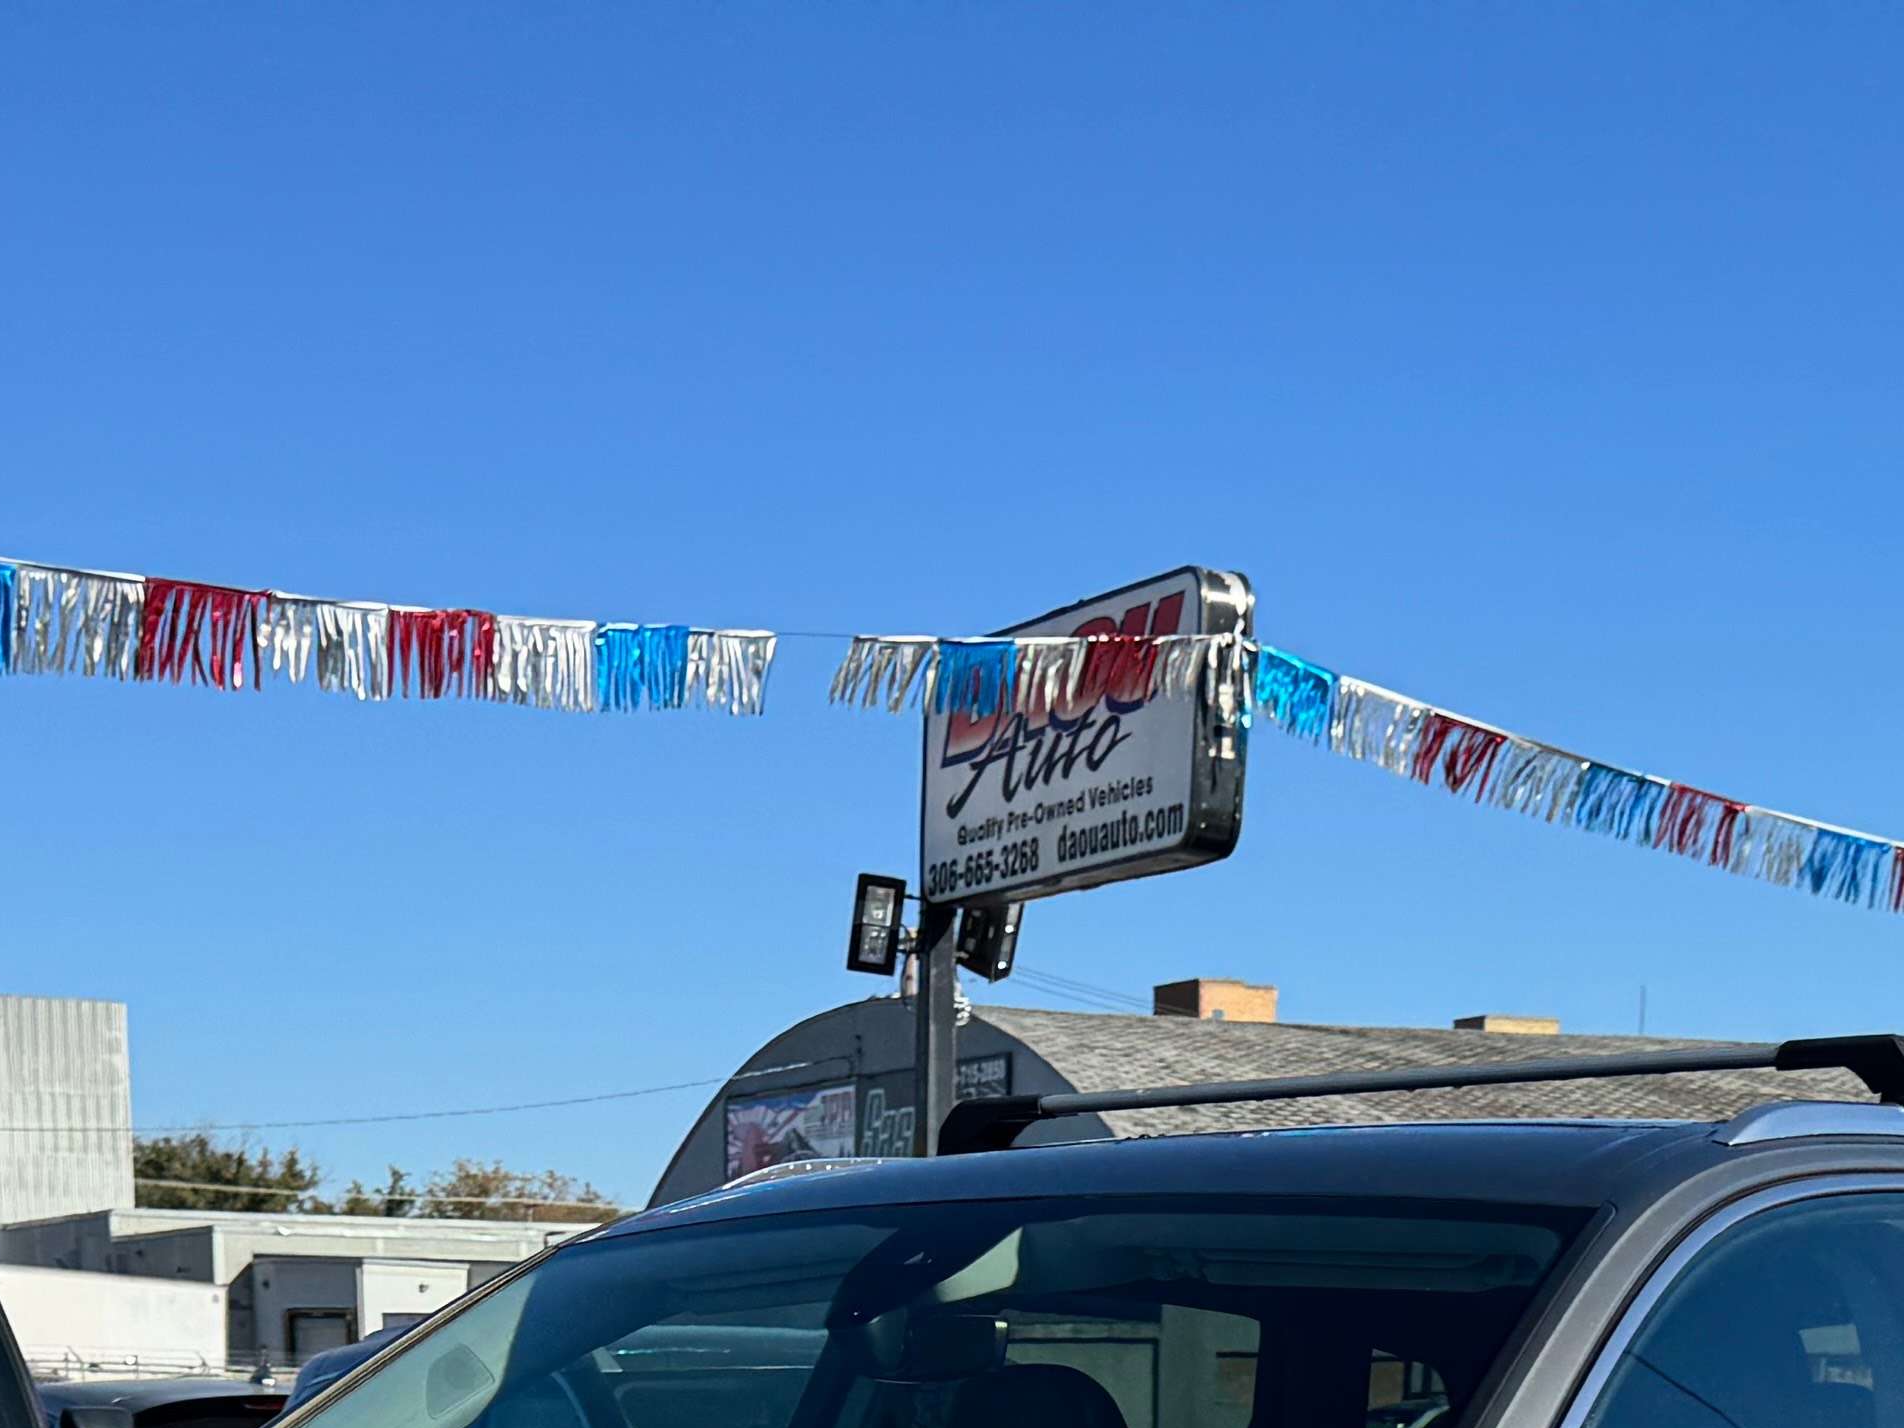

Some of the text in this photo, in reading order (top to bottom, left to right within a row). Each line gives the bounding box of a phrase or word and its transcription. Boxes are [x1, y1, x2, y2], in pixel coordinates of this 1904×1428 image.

[946, 712, 1132, 819] Auto
[957, 776, 1153, 847] Quality Pre-Owned Vehicles
[928, 802, 1184, 897] 306-665-3268 daouauto.com
